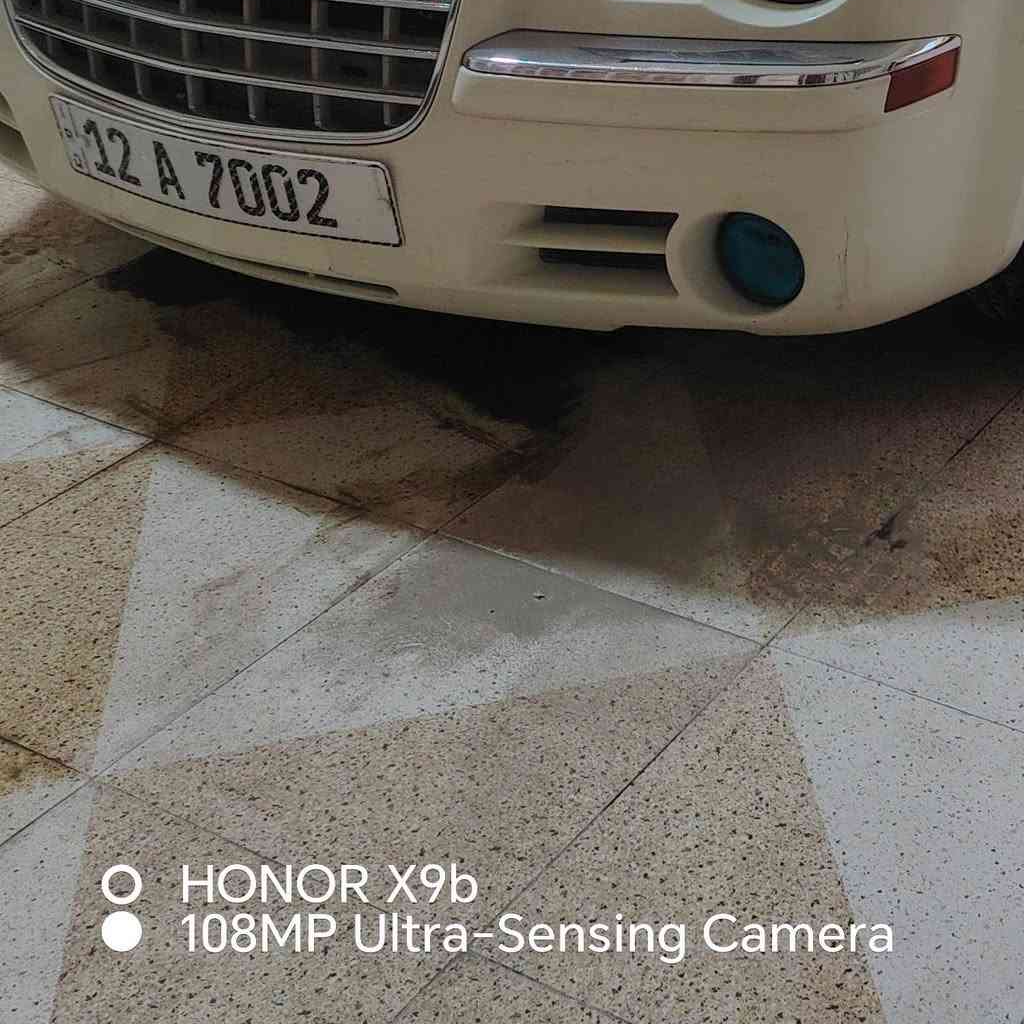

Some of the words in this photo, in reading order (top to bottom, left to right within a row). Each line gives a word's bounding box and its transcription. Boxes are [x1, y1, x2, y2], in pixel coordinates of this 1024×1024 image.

[83, 119, 141, 186] 12
[152, 140, 186, 200] A
[194, 149, 338, 228] 7002
